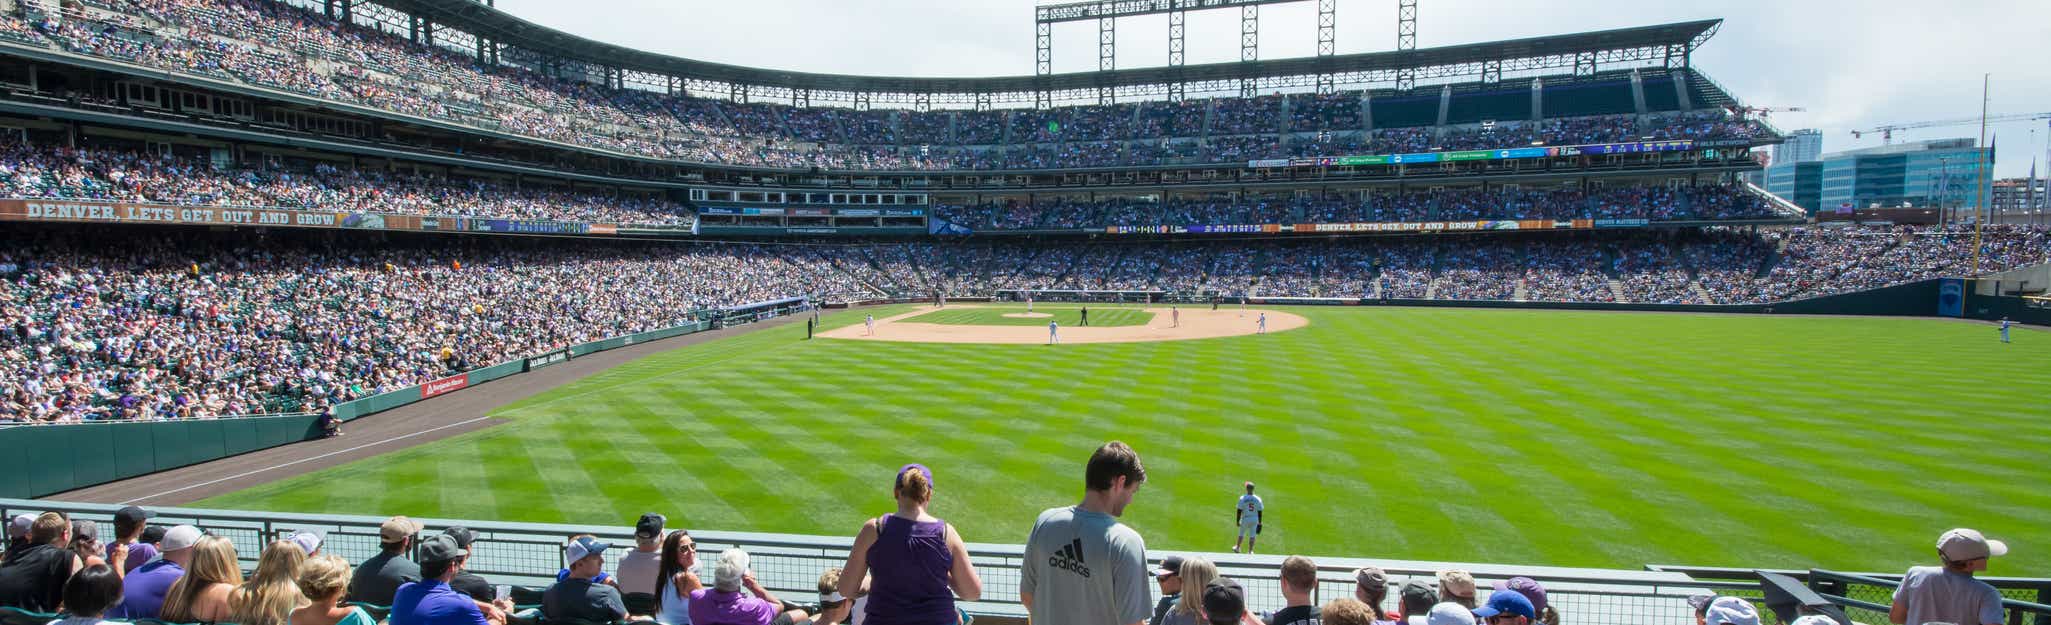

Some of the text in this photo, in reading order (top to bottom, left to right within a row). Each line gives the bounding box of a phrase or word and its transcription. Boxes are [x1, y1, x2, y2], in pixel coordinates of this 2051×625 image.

[27, 203, 335, 225] DENVER, LETS GET OUT AND GROW
[1403, 222, 1422, 230] OUT
[1424, 222, 1444, 230] AND
[1449, 222, 1477, 230] GROW
[1248, 503, 1255, 511] 5
[1048, 556, 1090, 578] adidas
